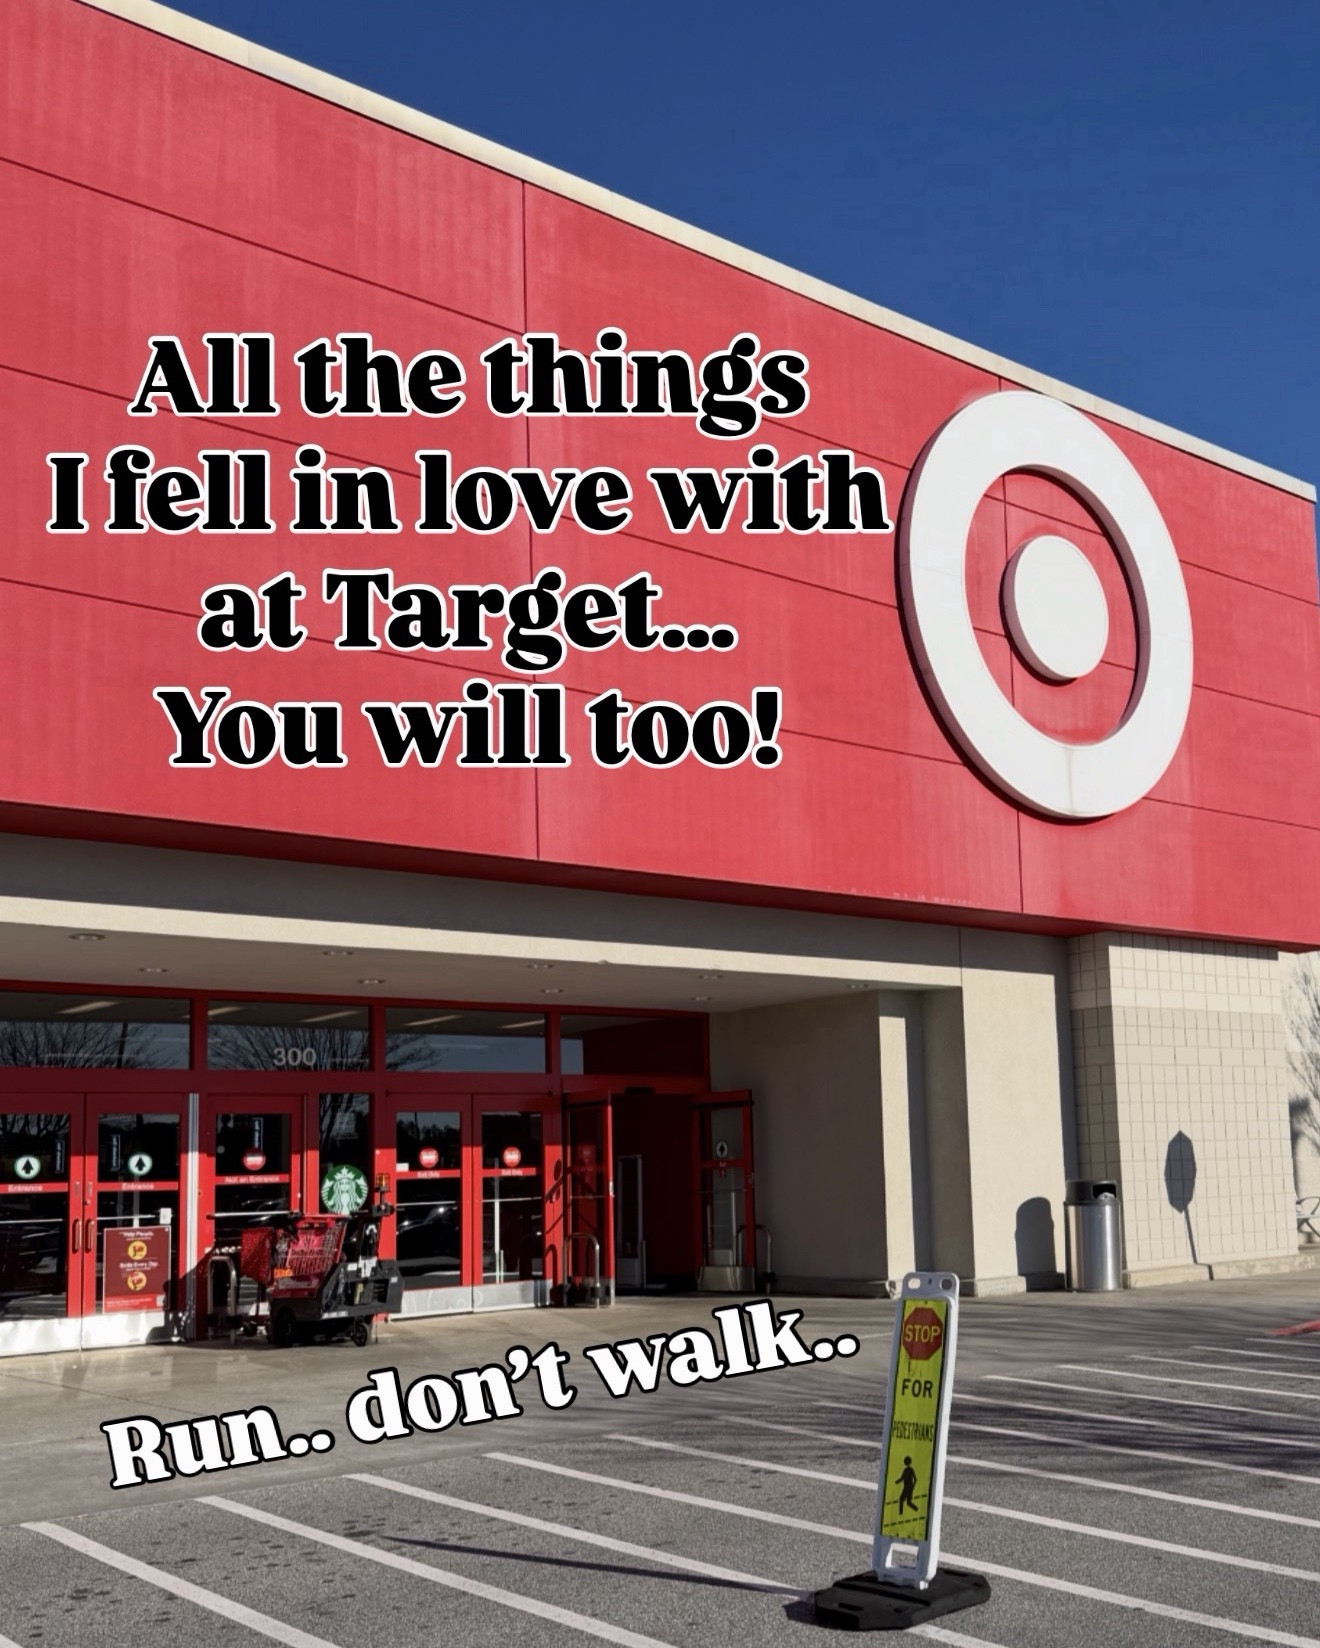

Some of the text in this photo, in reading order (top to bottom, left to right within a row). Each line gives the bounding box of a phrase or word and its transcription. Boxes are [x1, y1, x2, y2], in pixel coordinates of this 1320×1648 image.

[273, 1047, 317, 1066] 300
[121, 1182, 154, 1190] Entrance
[249, 1174, 279, 1183] Entrance
[8, 1184, 43, 1192] Entrance
[904, 1324, 941, 1342] STOP
[901, 1378, 934, 1398] FOR
[892, 1420, 934, 1442] PEDESTRIANS
